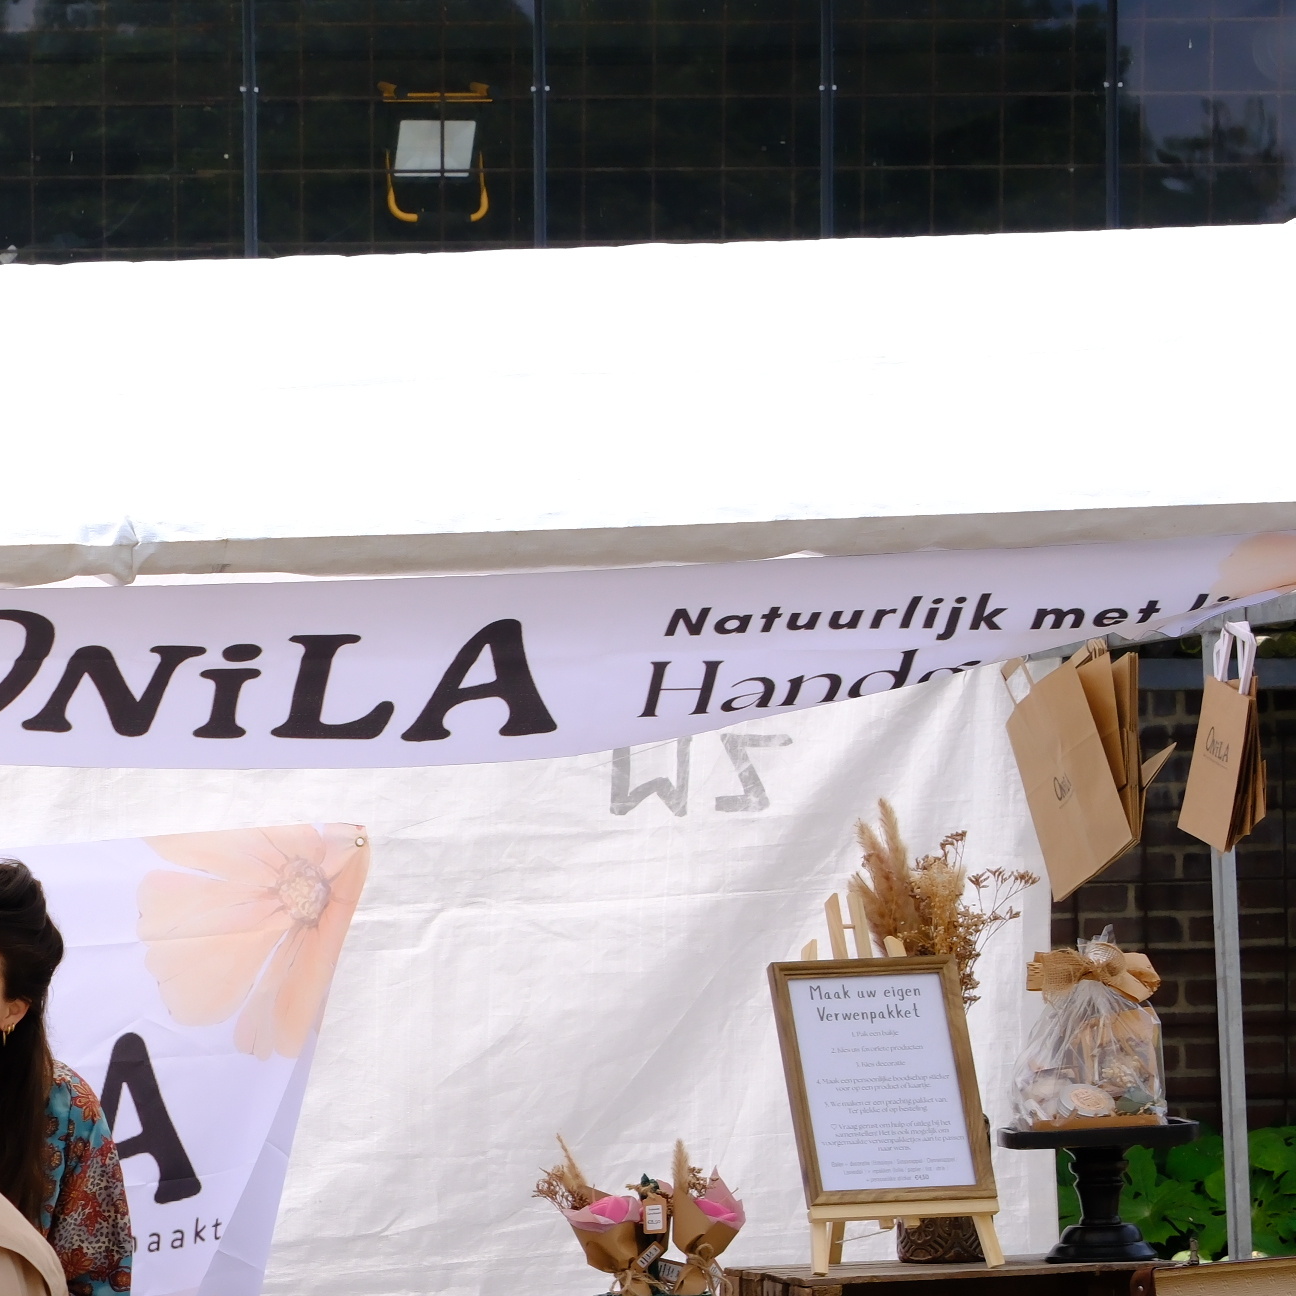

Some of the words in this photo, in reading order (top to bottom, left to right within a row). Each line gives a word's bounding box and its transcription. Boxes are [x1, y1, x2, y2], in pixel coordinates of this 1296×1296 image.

[665, 593, 1007, 640] Natuurlijk
[1030, 600, 1161, 629] met
[637, 648, 973, 717] Hand
[809, 984, 850, 1000] Maak
[857, 990, 876, 998] uw
[883, 987, 920, 1001] eigen
[817, 1003, 919, 1022] Verwenpakket
